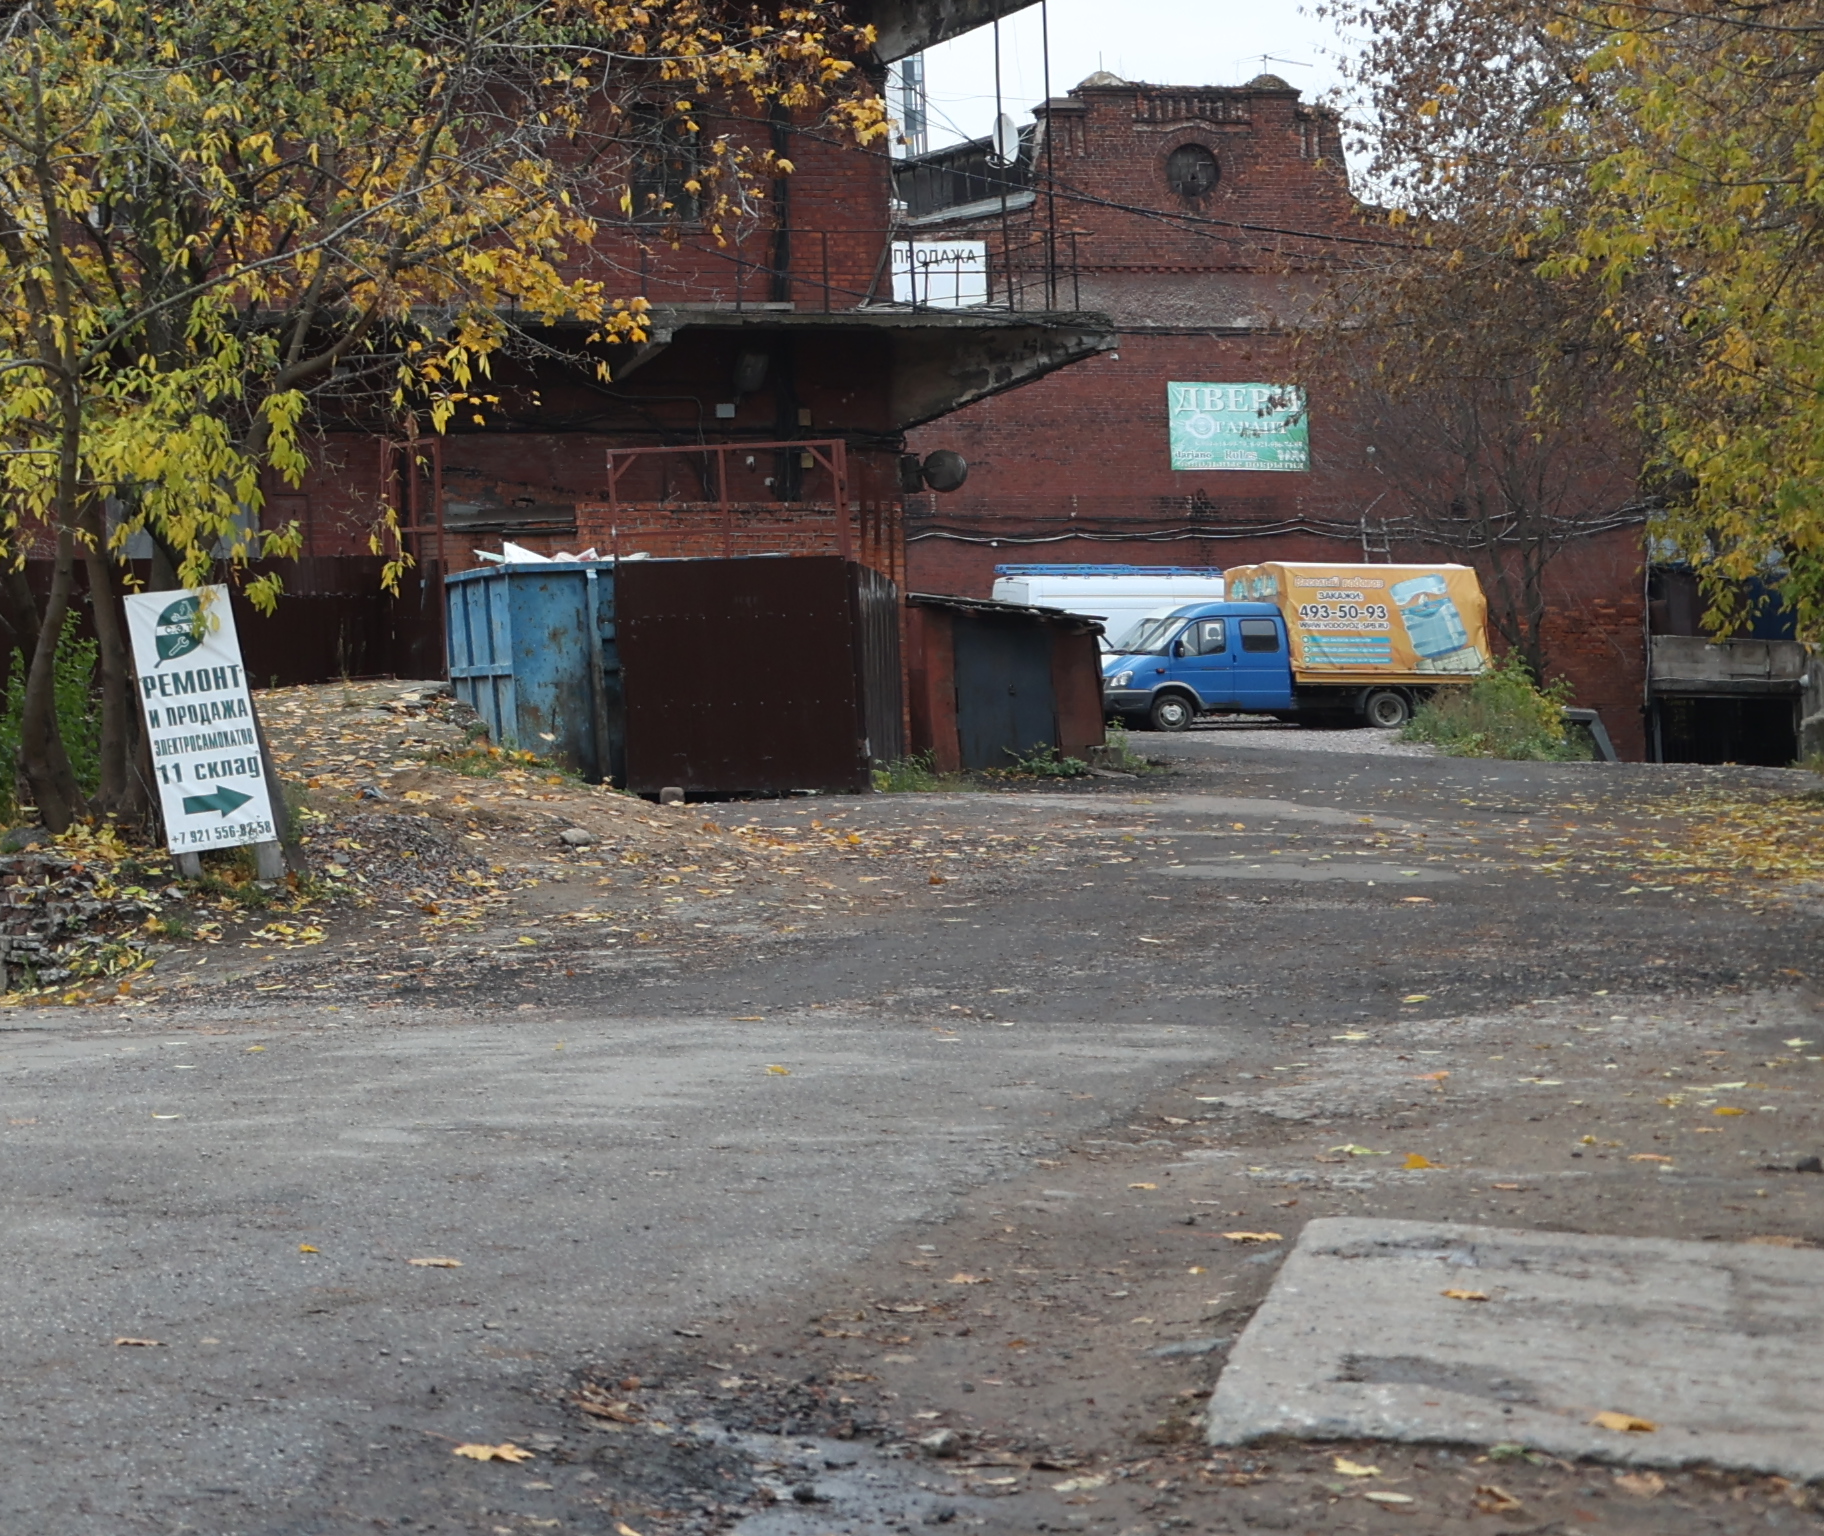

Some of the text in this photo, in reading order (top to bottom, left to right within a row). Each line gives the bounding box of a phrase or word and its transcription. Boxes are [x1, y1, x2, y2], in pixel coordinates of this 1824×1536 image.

[893, 248, 978, 266] ПРОДАЖА
[1175, 386, 1301, 415] ДВЕРИ
[1299, 604, 1387, 619] 493-50-93
[142, 664, 240, 700] РЕМОНТ
[148, 698, 249, 729] И ПРОДАЖА
[153, 728, 254, 757] ЭЛЕКТРОСАМОКАТОВ
[157, 762, 183, 785] 11
[172, 832, 186, 845] +7
[190, 828, 211, 844] 921
